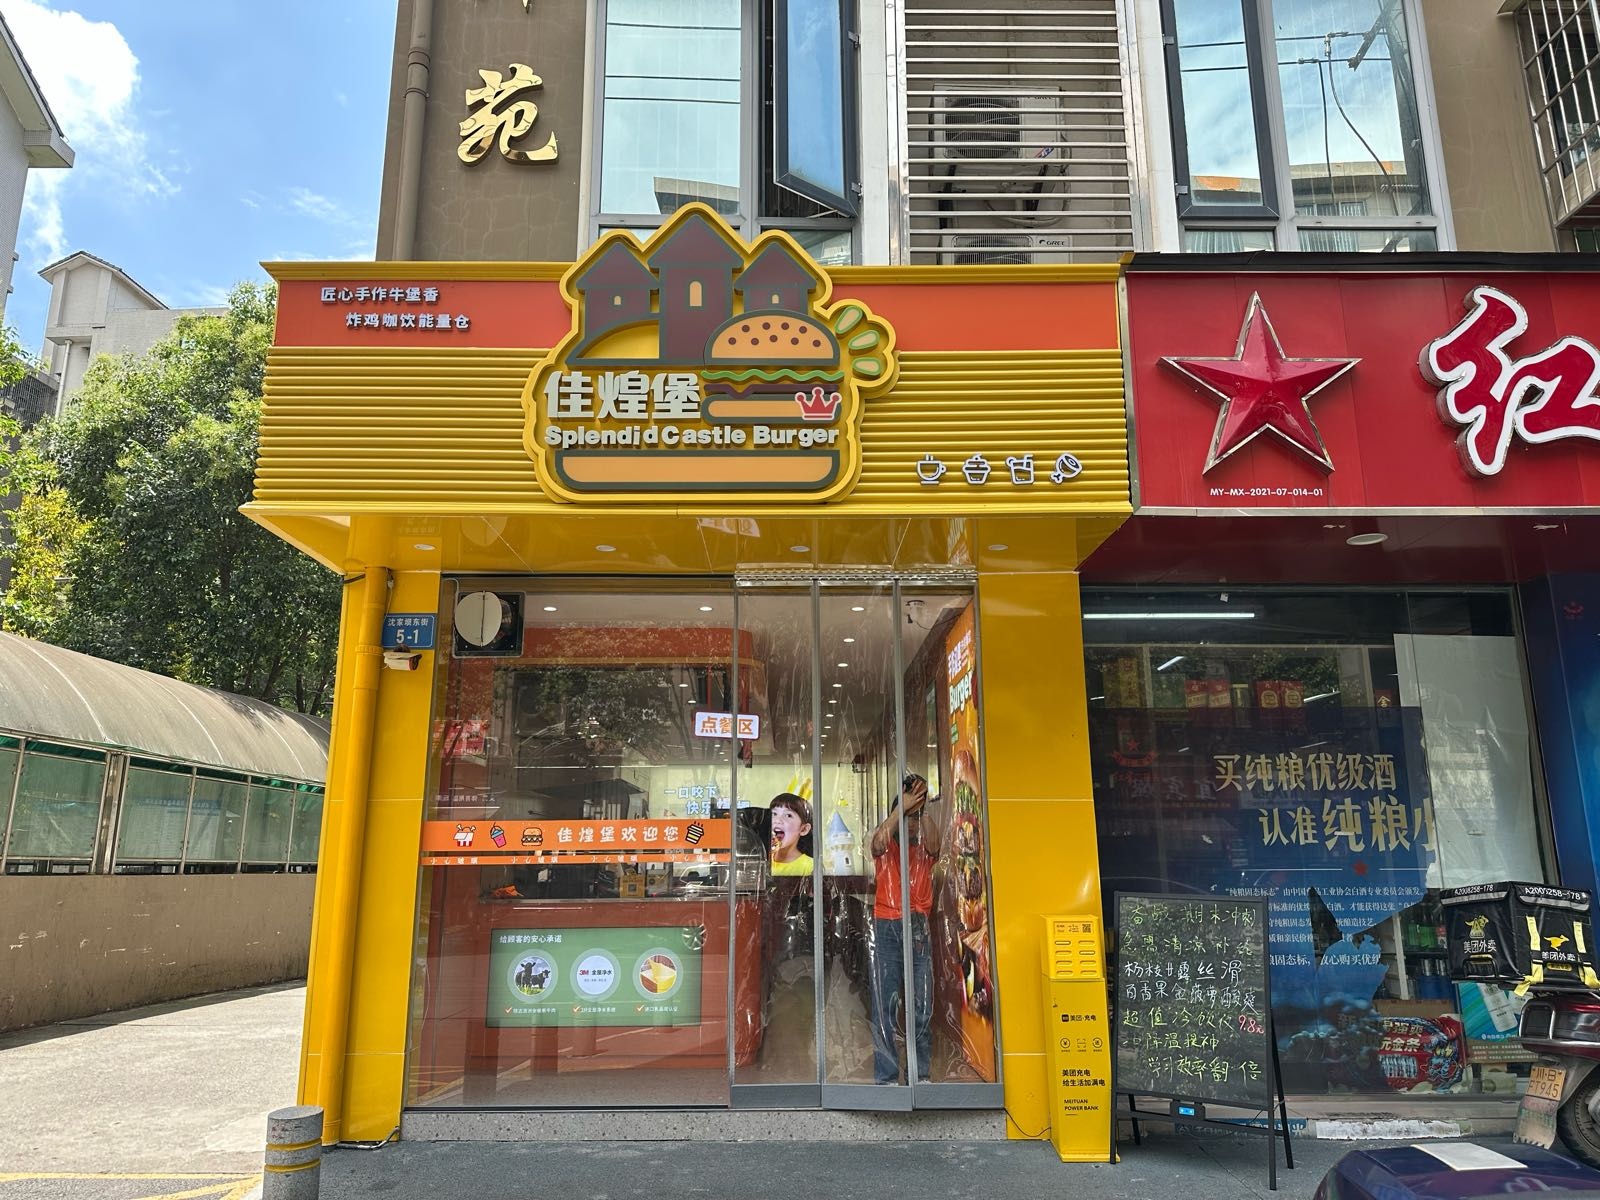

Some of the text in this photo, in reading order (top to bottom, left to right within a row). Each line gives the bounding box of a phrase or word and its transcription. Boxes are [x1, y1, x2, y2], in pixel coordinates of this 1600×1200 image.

[457, 62, 558, 166] 苑
[321, 286, 439, 303] 匠心手作牛堡香
[346, 312, 471, 330] 炸鸡咖饮能量仓
[1418, 284, 1600, 479] 红
[543, 370, 701, 420] 佳煌堡
[753, 425, 839, 447] Burger
[1210, 487, 1324, 497] MY-MX-2021-07-014-01
[396, 629, 419, 644] 5-1
[701, 716, 753, 735] 点餐区
[1213, 752, 1397, 792] 买纯粮优级酒
[664, 785, 718, 799] 一口咬下
[557, 826, 679, 843] 佳煌堡欢迎您
[499, 934, 562, 943] 给顾客的安心承诺
[1463, 940, 1497, 953] 美团外卖
[1541, 951, 1576, 962] 美团外卖
[1123, 960, 1243, 988] 杨枝甘露丝滑
[1062, 1069, 1091, 1077] 美团充电
[1062, 1079, 1106, 1087] 给生活加满电
